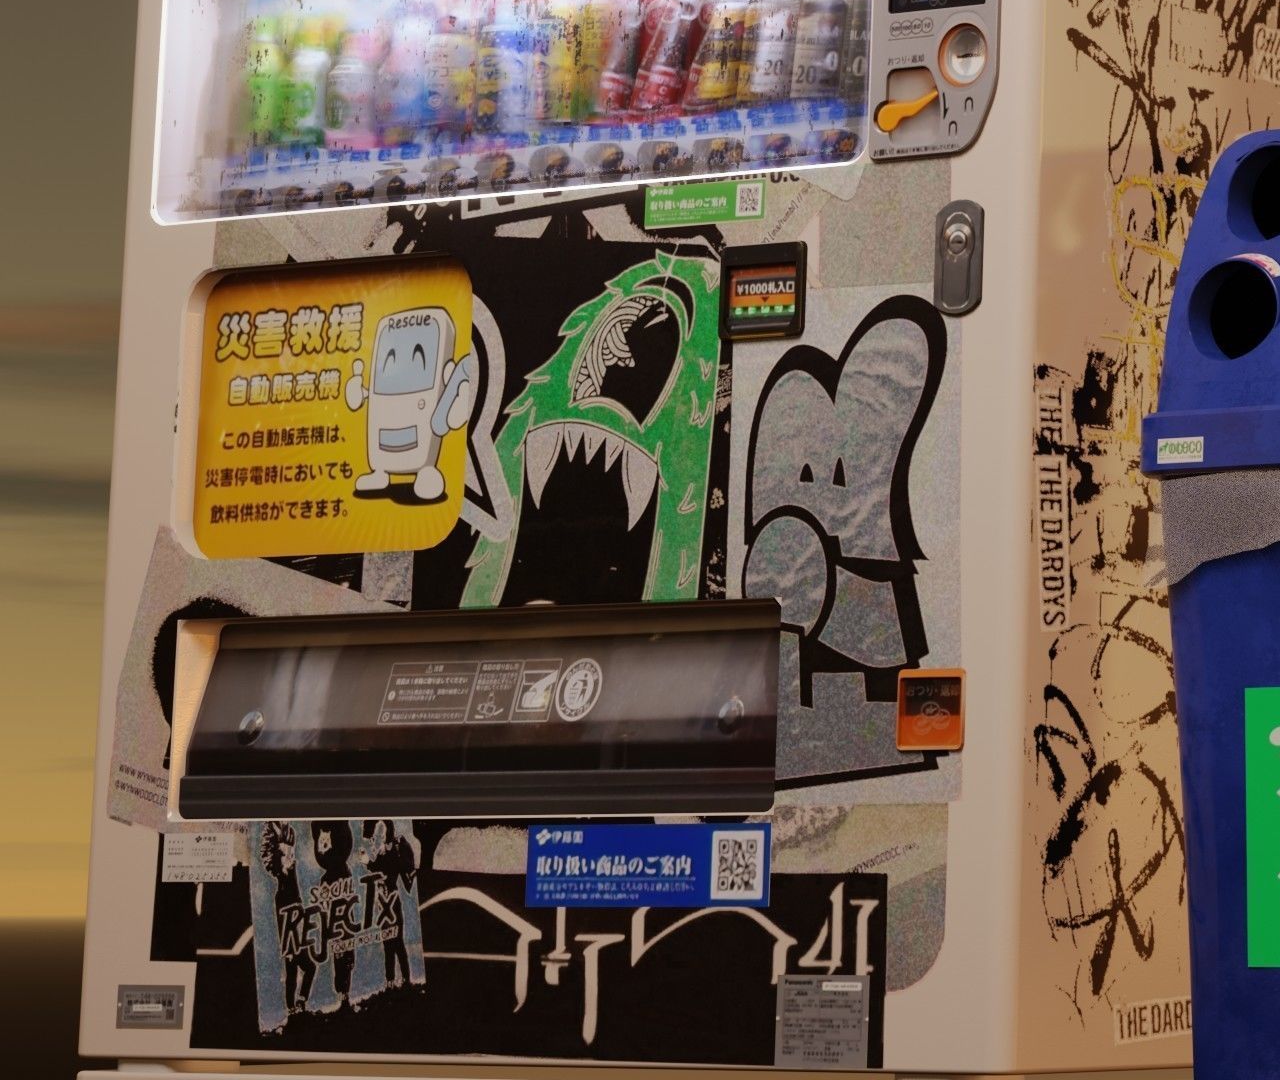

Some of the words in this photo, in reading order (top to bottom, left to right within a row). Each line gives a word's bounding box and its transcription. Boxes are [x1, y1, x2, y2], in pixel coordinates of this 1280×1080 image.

[736, 280, 796, 296] ¥1000札入口
[214, 301, 364, 363] 災害救援
[387, 314, 432, 332] Rescue
[228, 368, 341, 406] 自動販売機
[1039, 387, 1064, 444] THE
[221, 424, 347, 451] この自動販売機は、
[204, 461, 354, 489] 災害停電時においても
[1039, 462, 1064, 512] THE
[210, 497, 348, 524] 飲料供給ができます。
[1041, 519, 1067, 627] DARDYS
[536, 855, 692, 877] 取り扱い商品のご案内
[1117, 1005, 1148, 1040] THE
[1151, 999, 1193, 1035] DARD
